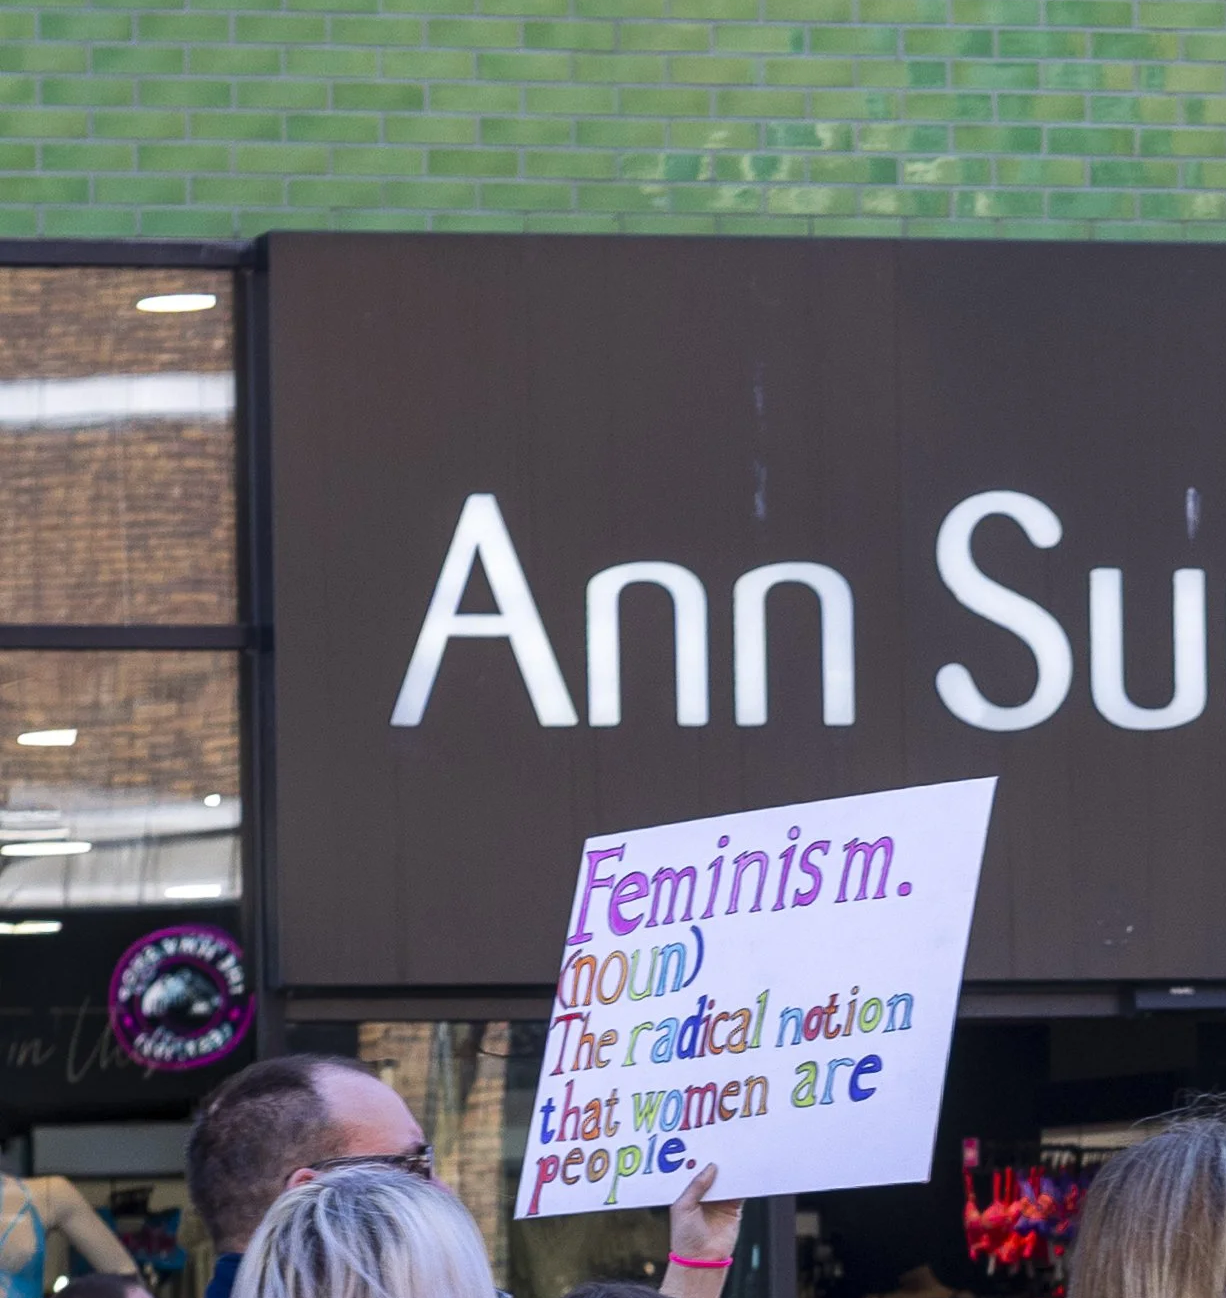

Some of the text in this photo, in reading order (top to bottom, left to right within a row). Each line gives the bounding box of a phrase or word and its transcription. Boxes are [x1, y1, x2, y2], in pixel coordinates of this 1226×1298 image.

[390, 492, 856, 728] Ann
[566, 825, 913, 947] Feminism.
[557, 924, 705, 1010] (noun)
[549, 985, 915, 1076] The radical notion
[540, 1053, 883, 1145] that women are
[527, 1134, 697, 1217] people.
